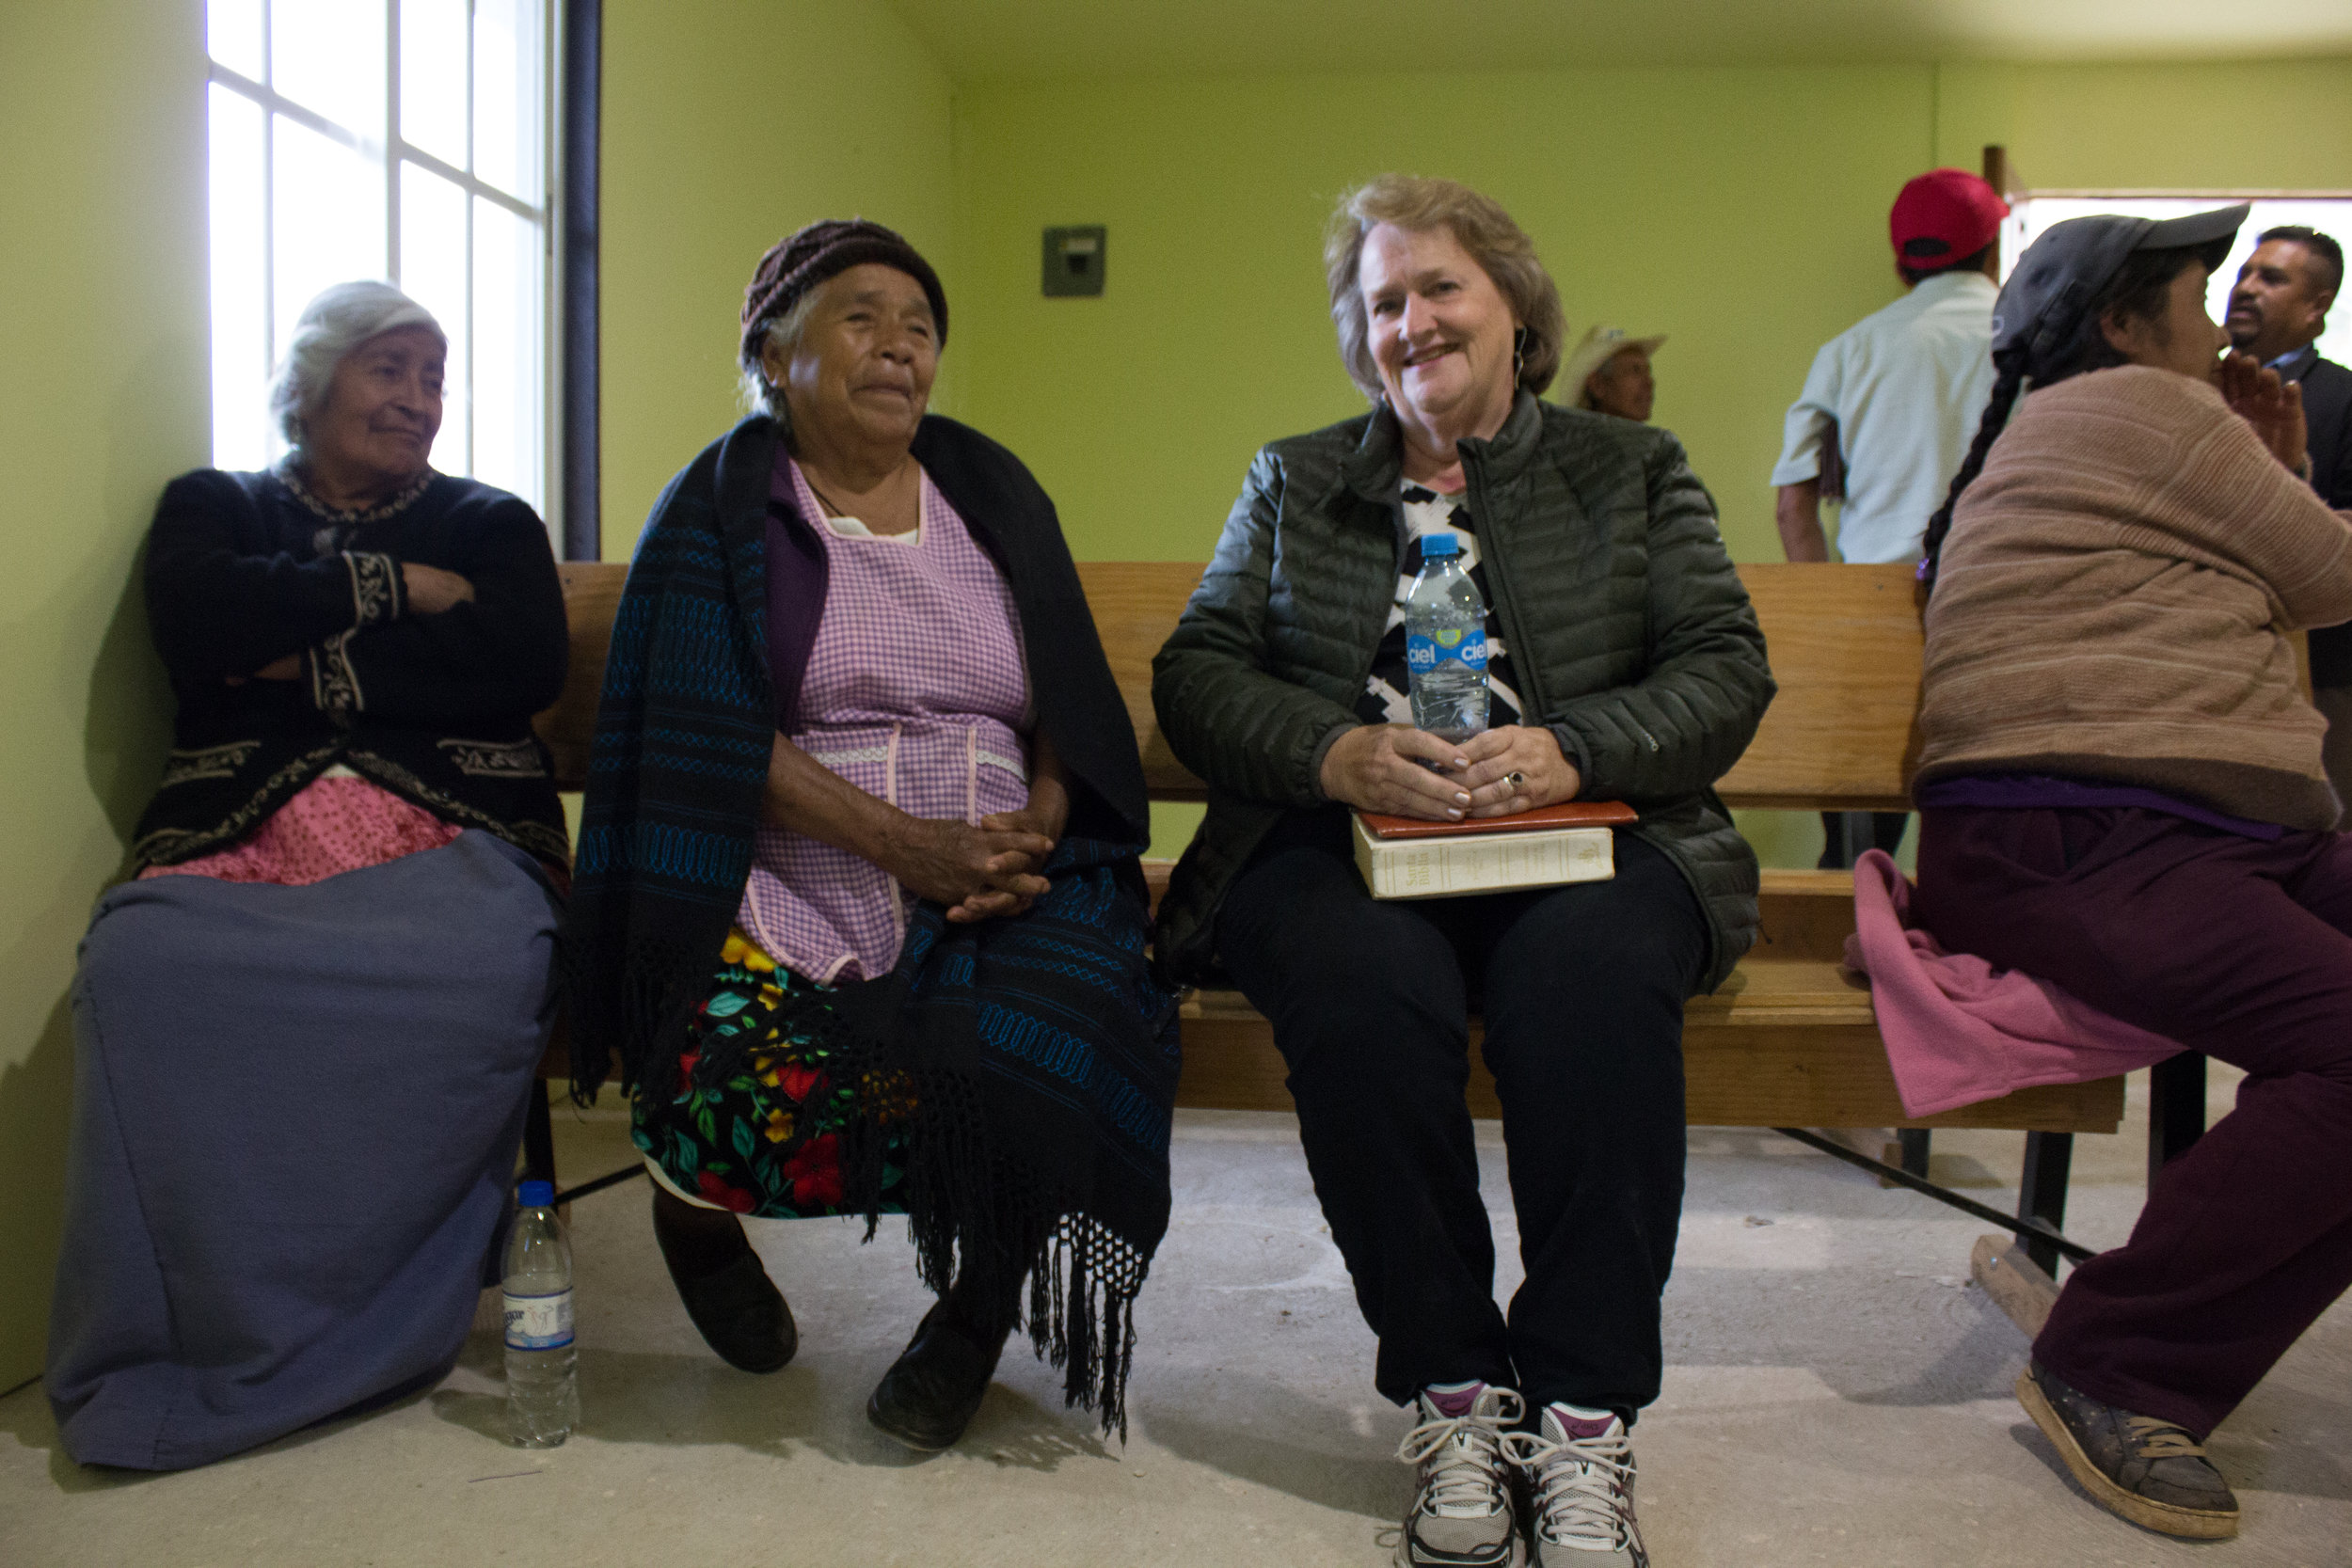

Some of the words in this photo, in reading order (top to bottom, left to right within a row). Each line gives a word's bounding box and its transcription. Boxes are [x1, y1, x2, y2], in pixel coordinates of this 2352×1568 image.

[1408, 641, 1436, 664] ciel
[1406, 853, 1417, 887] Santa
[1418, 851, 1430, 886] Biblia
